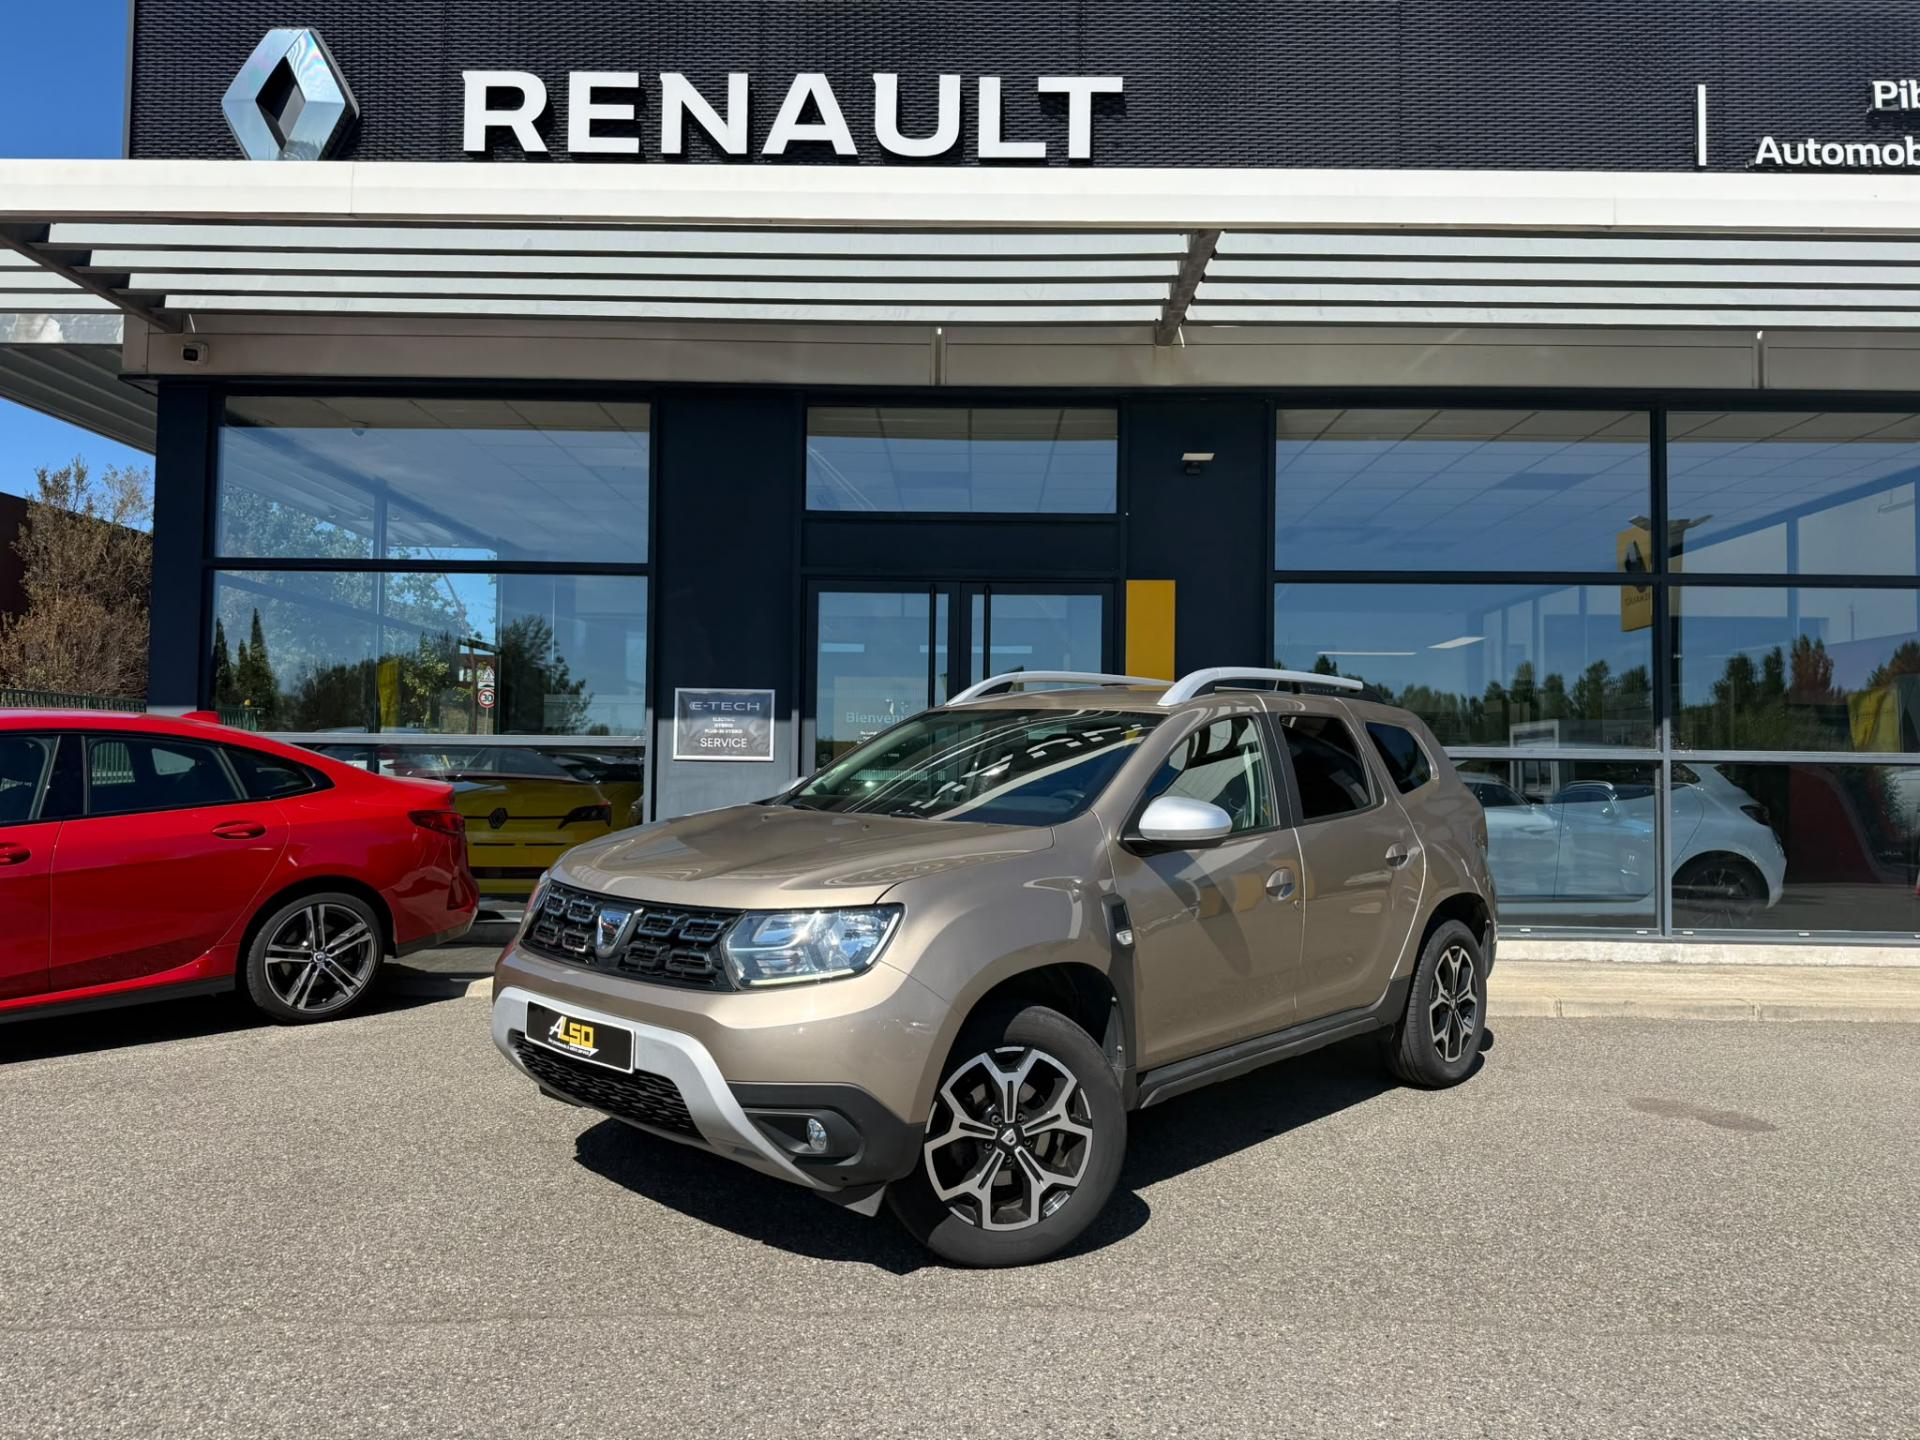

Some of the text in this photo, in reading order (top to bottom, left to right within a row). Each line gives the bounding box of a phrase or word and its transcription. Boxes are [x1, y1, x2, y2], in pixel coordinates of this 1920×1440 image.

[462, 69, 1124, 160] RENAULT
[1755, 135, 1920, 166] Automob
[689, 701, 760, 712] E-TECH
[700, 737, 748, 748] SERVICE
